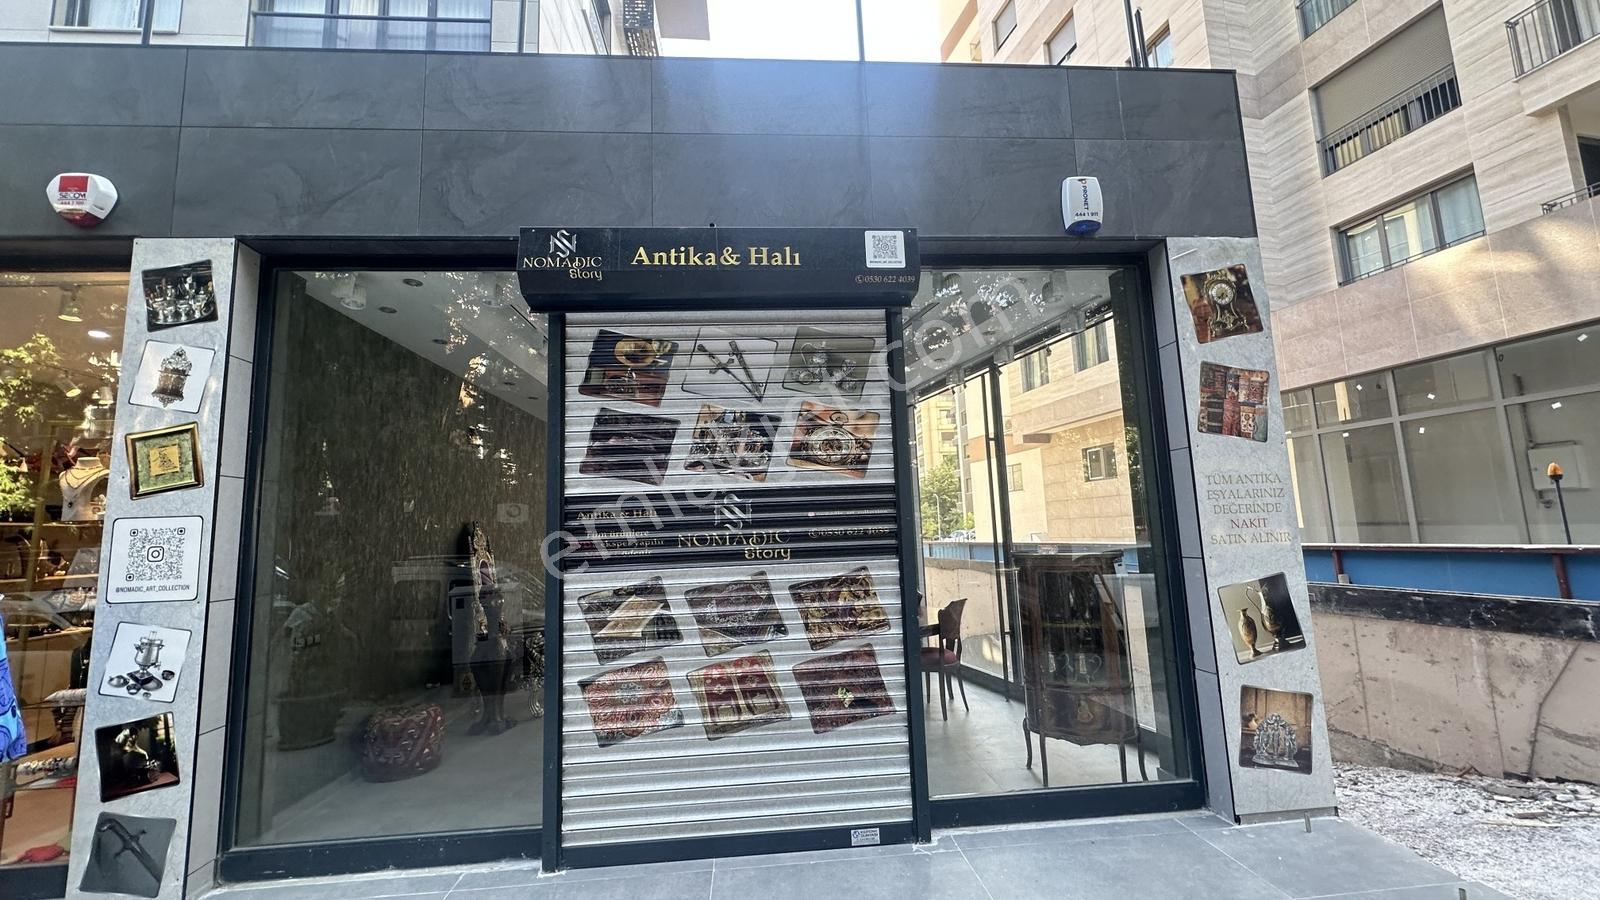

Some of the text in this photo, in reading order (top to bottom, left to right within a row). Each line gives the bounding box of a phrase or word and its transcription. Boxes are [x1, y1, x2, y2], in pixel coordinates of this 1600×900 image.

[522, 256, 602, 270] NOMADIC
[569, 268, 602, 281] Story
[864, 275, 882, 283] 0530
[883, 275, 897, 283] 622
[1206, 473, 1232, 485] TÜM
[1207, 488, 1285, 501] EŞYALARINIZ
[1213, 502, 1282, 514] DEĞERİNDE
[677, 530, 791, 548] NOMADIC
[1210, 531, 1292, 545] SATIN ALINIR
[744, 547, 790, 561] Story
[115, 584, 190, 593] @NOMADIC_ART_COLLECTION
